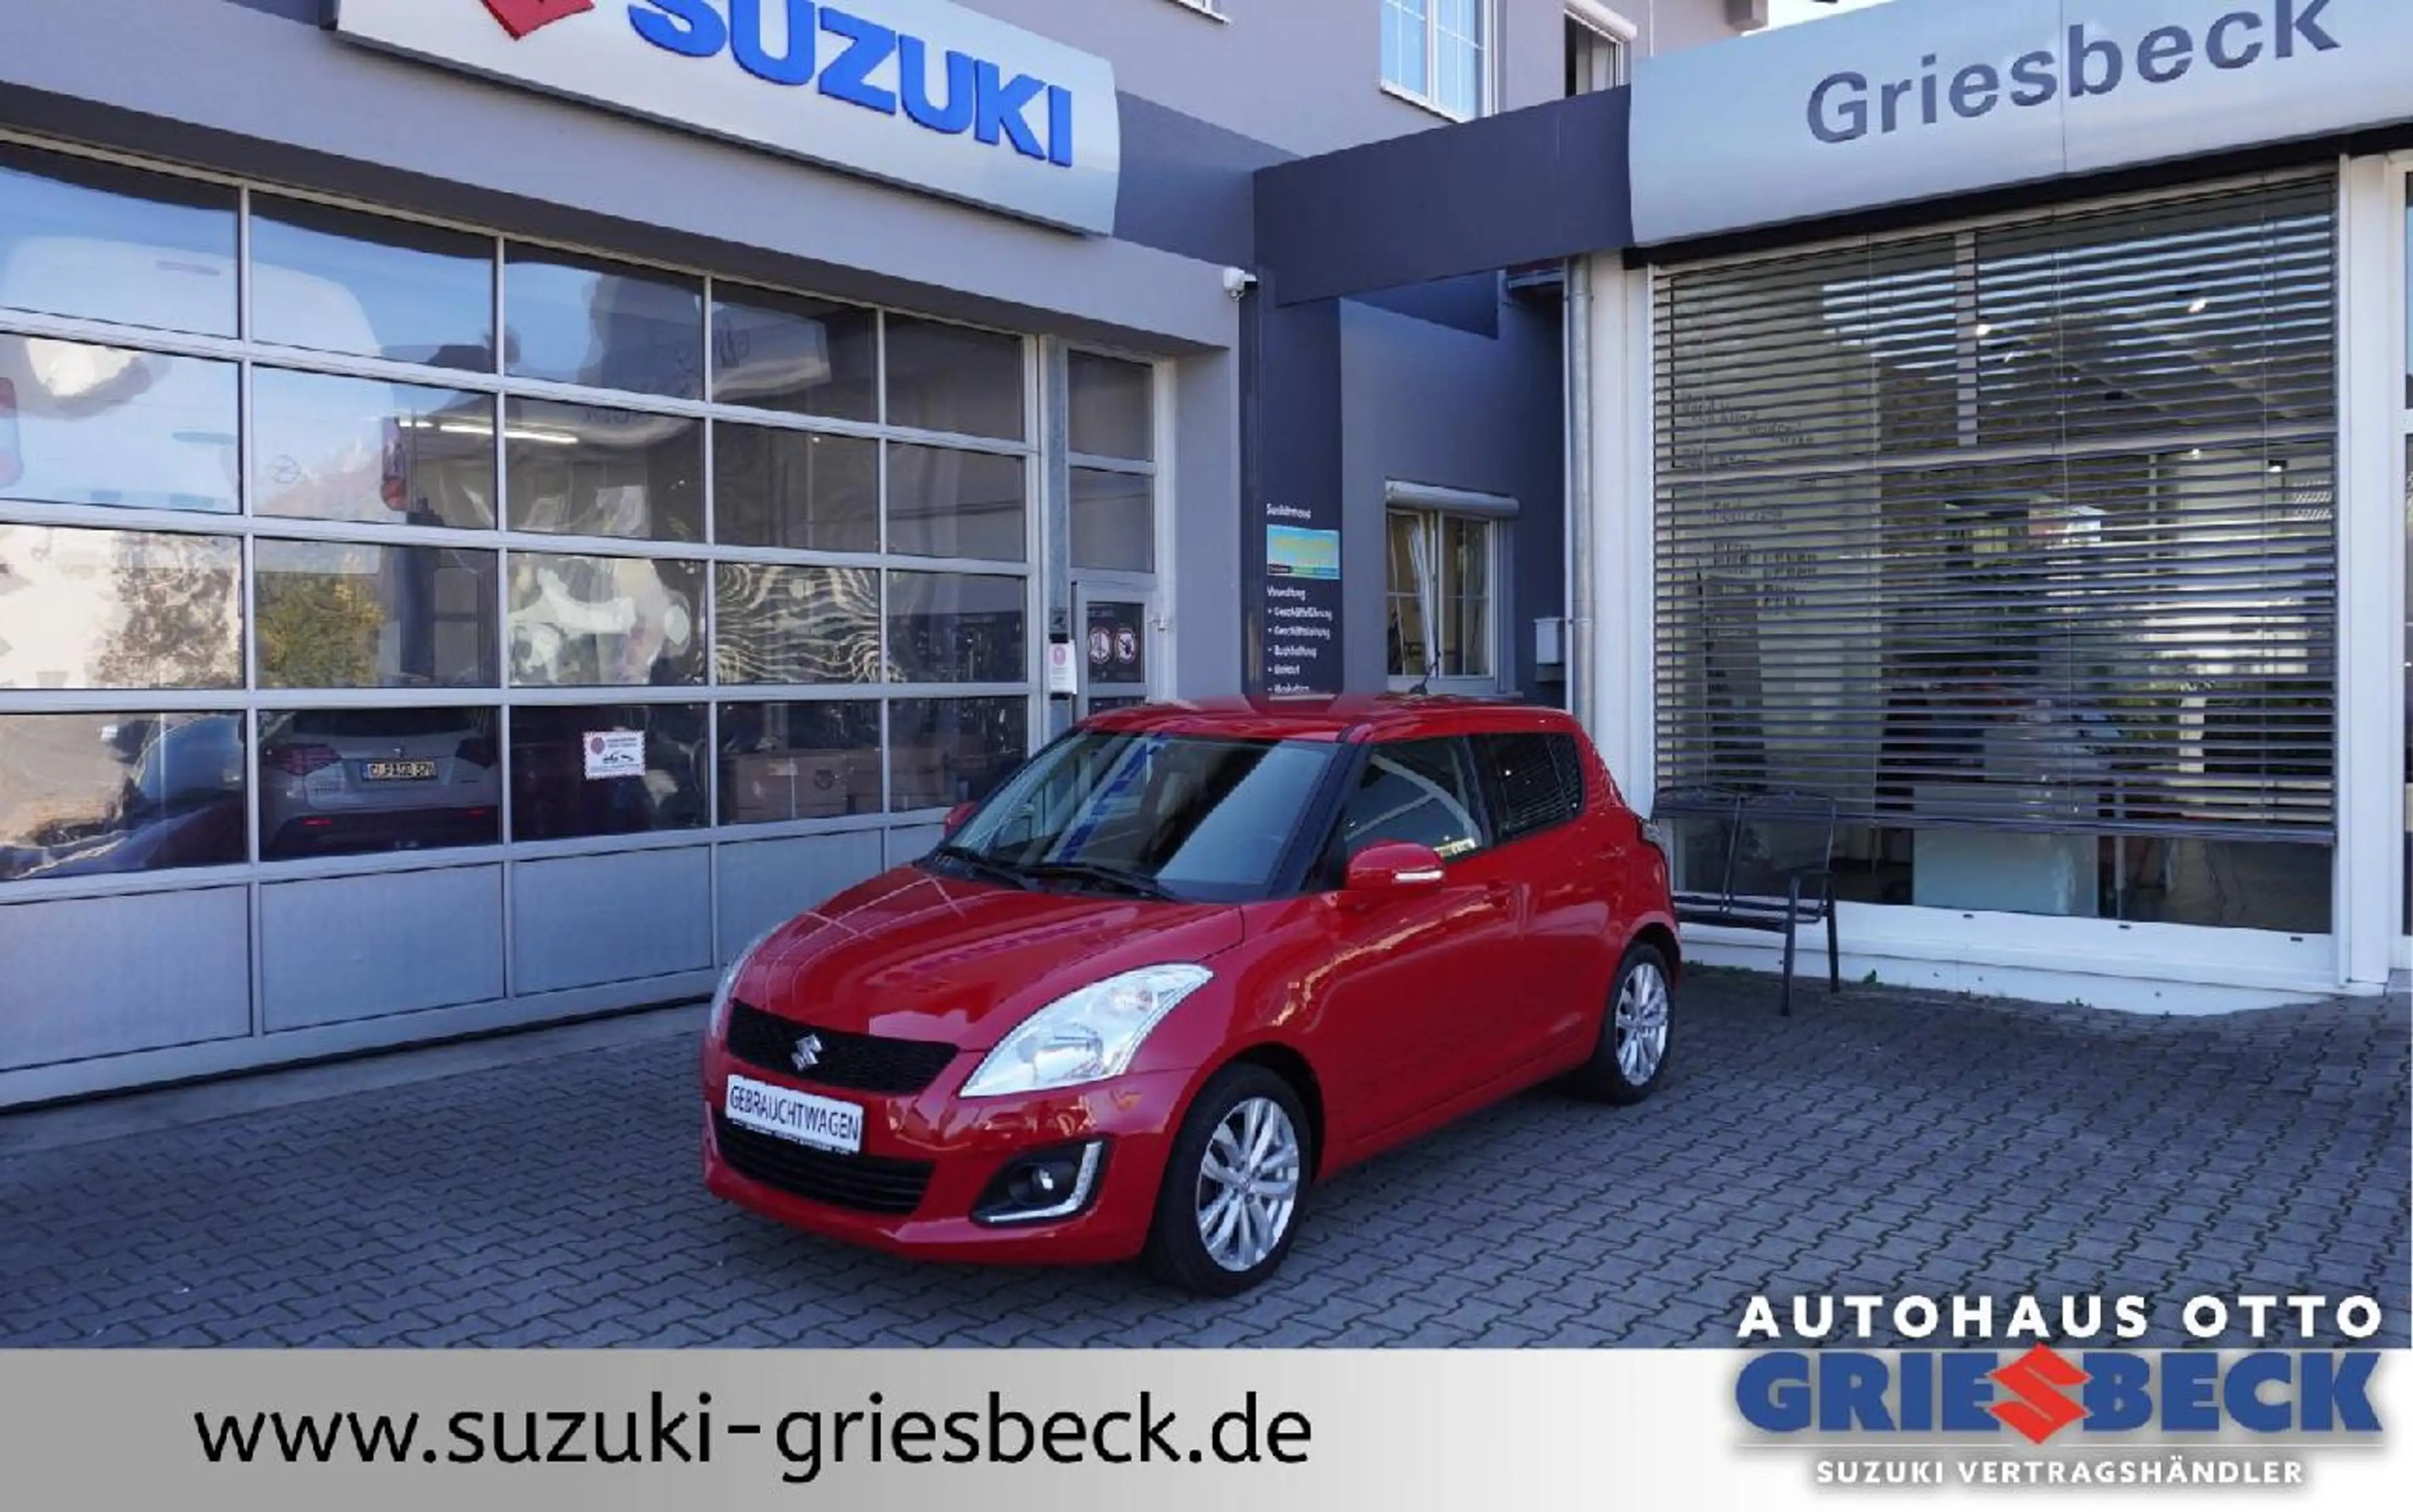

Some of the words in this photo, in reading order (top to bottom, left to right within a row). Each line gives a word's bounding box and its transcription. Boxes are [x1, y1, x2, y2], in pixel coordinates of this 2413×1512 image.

[627, 0, 1072, 168] SUZUKI
[1806, 0, 2341, 144] Griesbeck
[730, 1085, 858, 1141] GEBRAUCHTWAGEN
